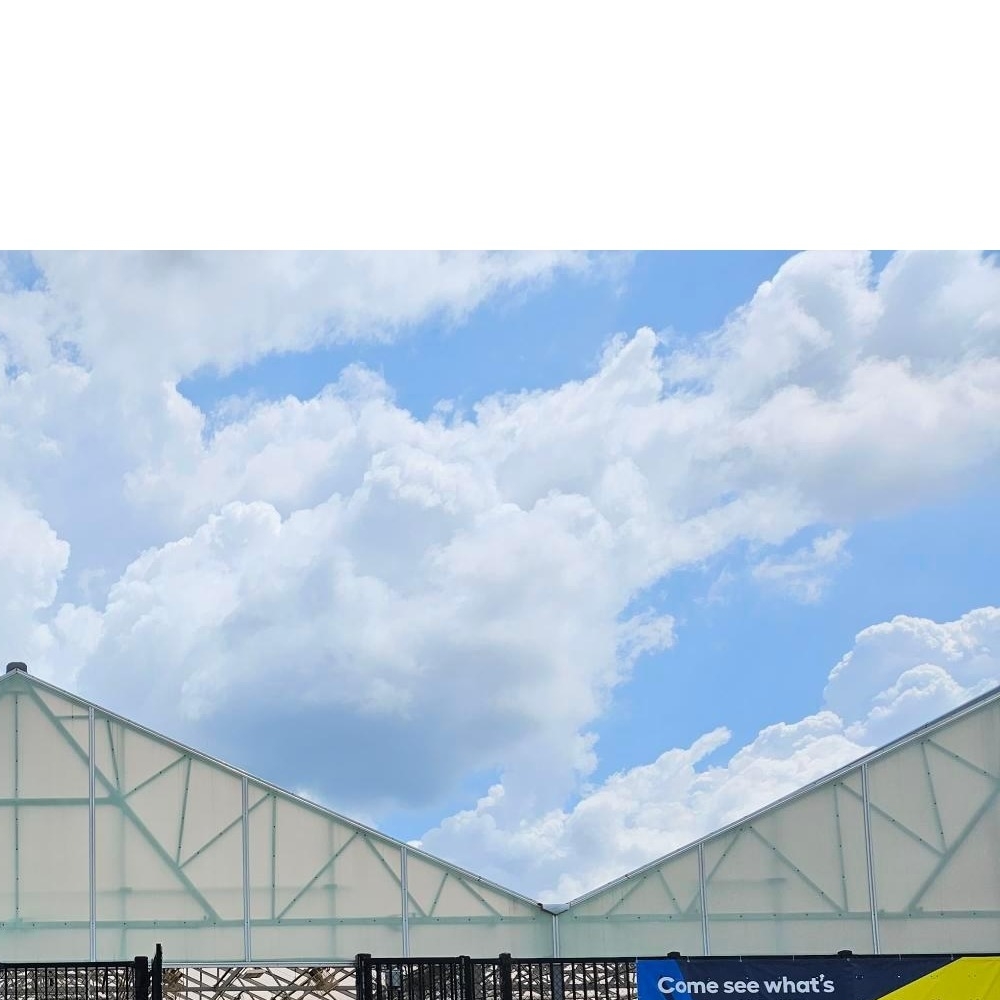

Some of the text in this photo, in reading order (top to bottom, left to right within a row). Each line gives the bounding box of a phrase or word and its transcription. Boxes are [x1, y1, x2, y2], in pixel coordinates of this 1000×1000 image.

[657, 974, 835, 994] Come see what's
